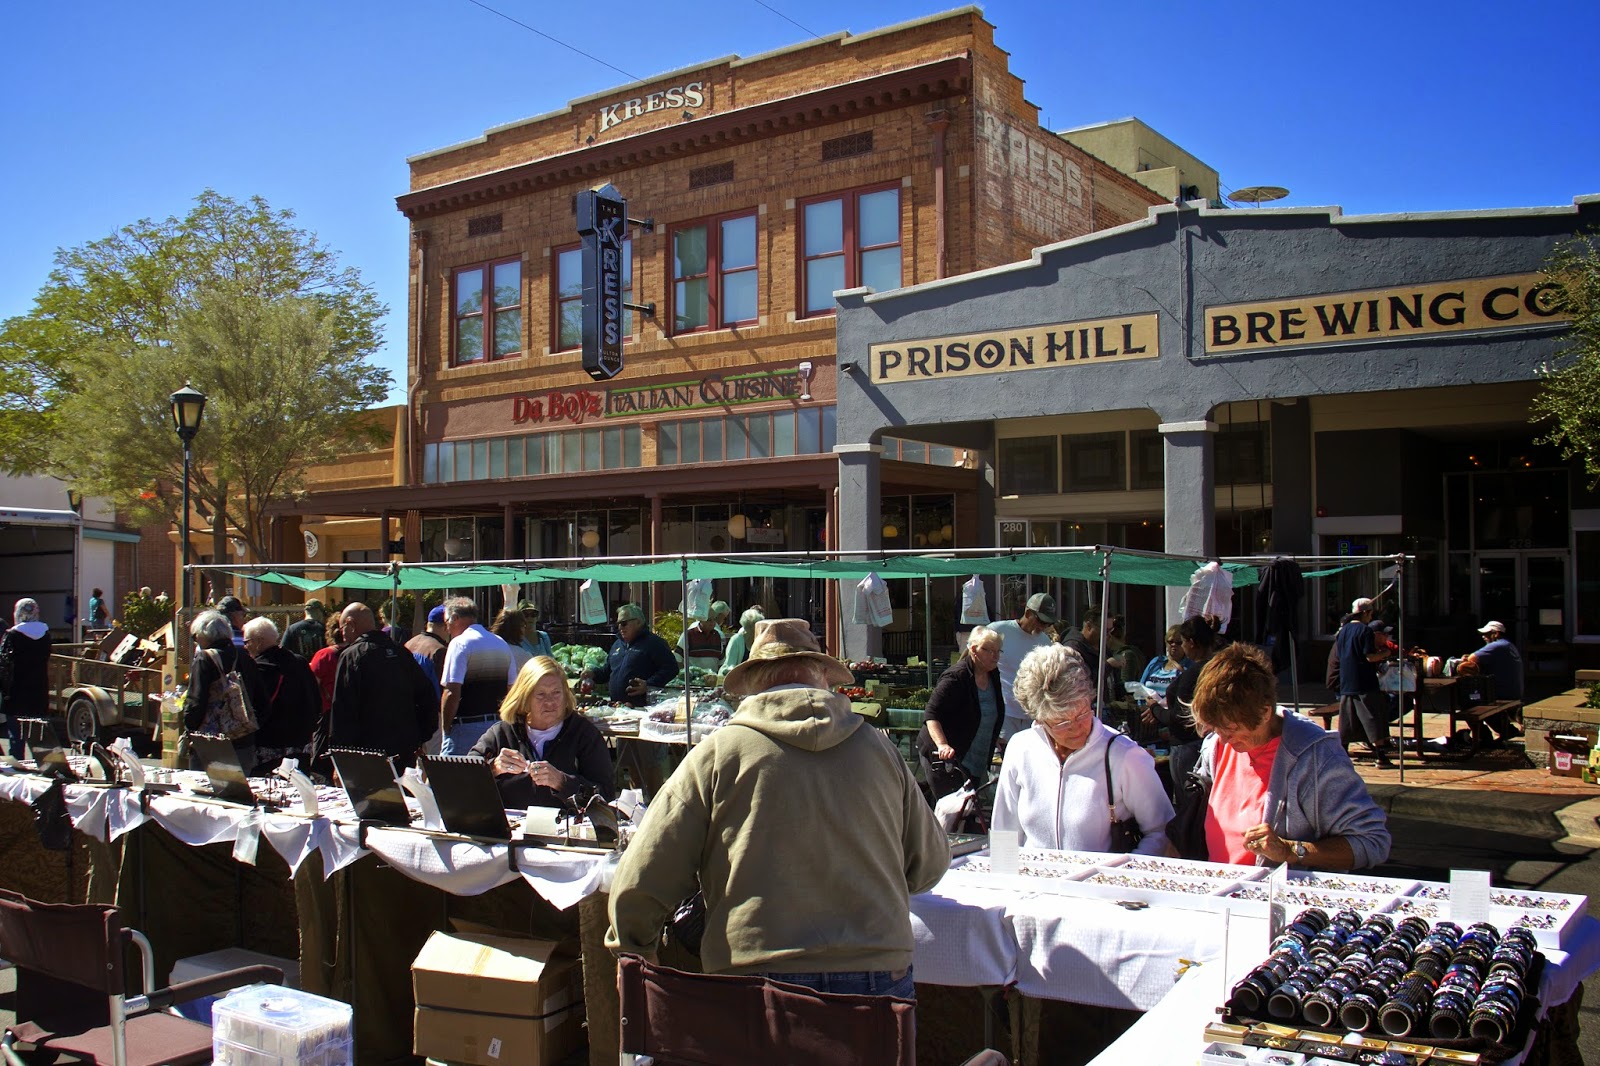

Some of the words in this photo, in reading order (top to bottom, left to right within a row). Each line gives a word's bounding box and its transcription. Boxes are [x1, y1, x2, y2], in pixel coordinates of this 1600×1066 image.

[600, 81, 703, 133] KRESS
[984, 110, 1083, 209] KRESS
[602, 205, 617, 215] THE
[600, 216, 621, 345] KRESS
[1211, 290, 1466, 346] BREWING
[879, 336, 1035, 379] PRISON
[1043, 324, 1147, 363] HILL
[511, 395, 543, 422] Da
[1003, 522, 1023, 532] 280
